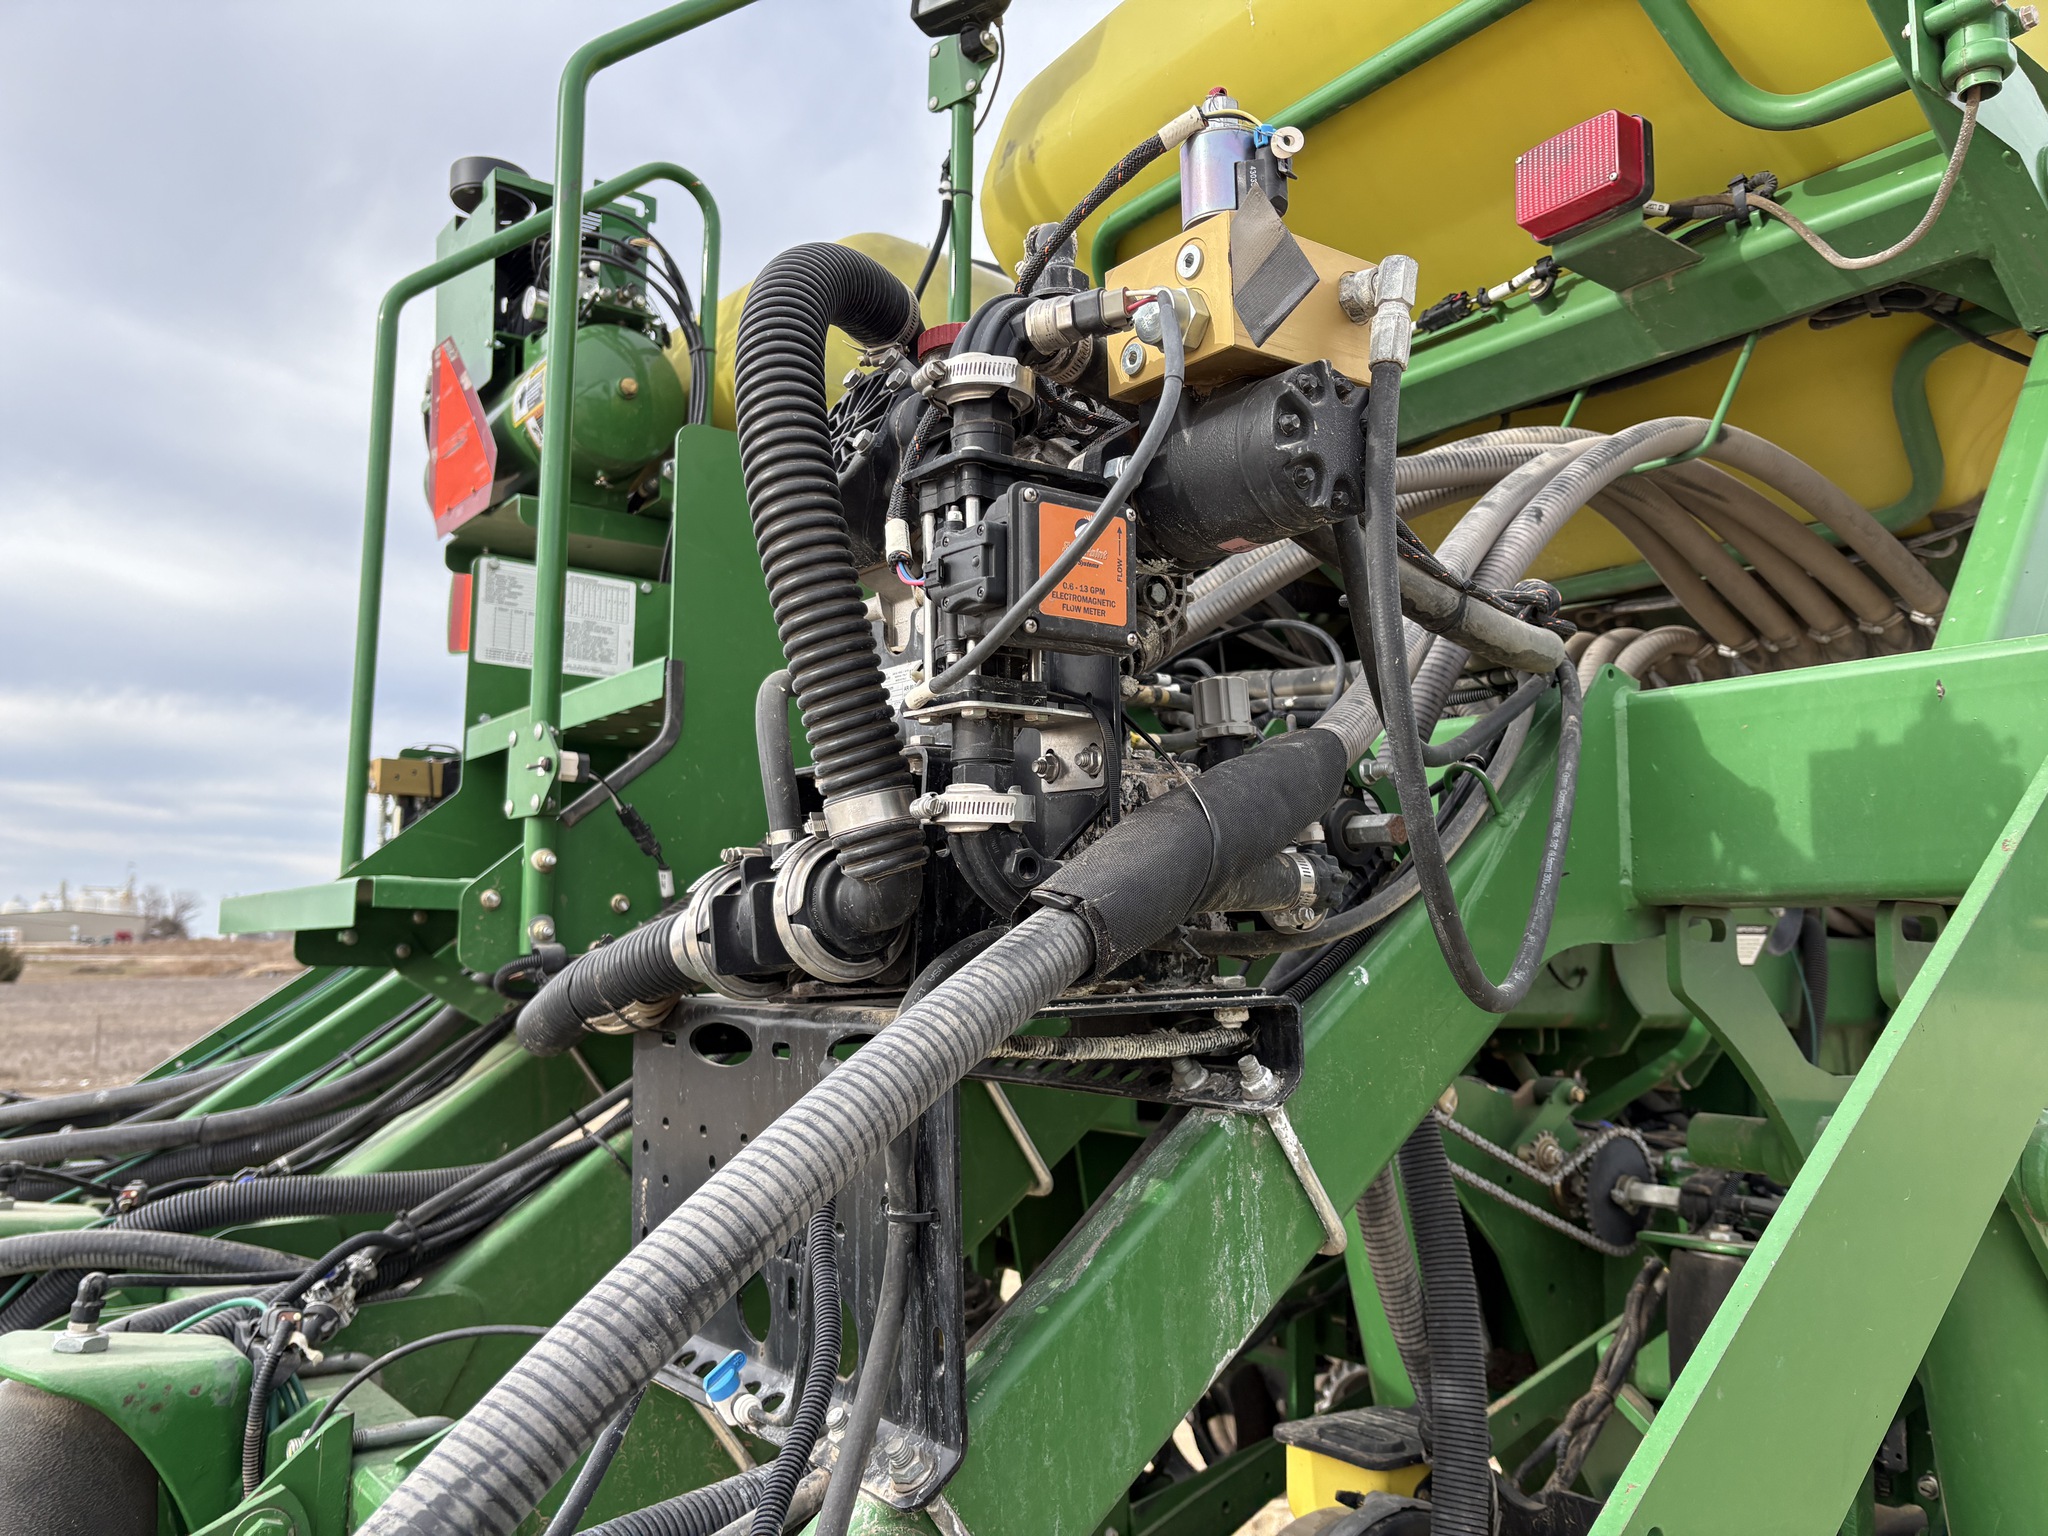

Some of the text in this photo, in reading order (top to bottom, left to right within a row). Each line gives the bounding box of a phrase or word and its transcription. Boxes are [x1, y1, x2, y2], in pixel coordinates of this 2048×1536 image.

[1063, 582, 1074, 591] 0.6
[1090, 586, 1106, 596] GPM
[1052, 591, 1116, 608] ELECTROMAGNETIC
[1062, 604, 1106, 617] FLOW METER
[964, 935, 989, 952] MADE
[948, 951, 961, 963] IN
[928, 964, 947, 982] USA
